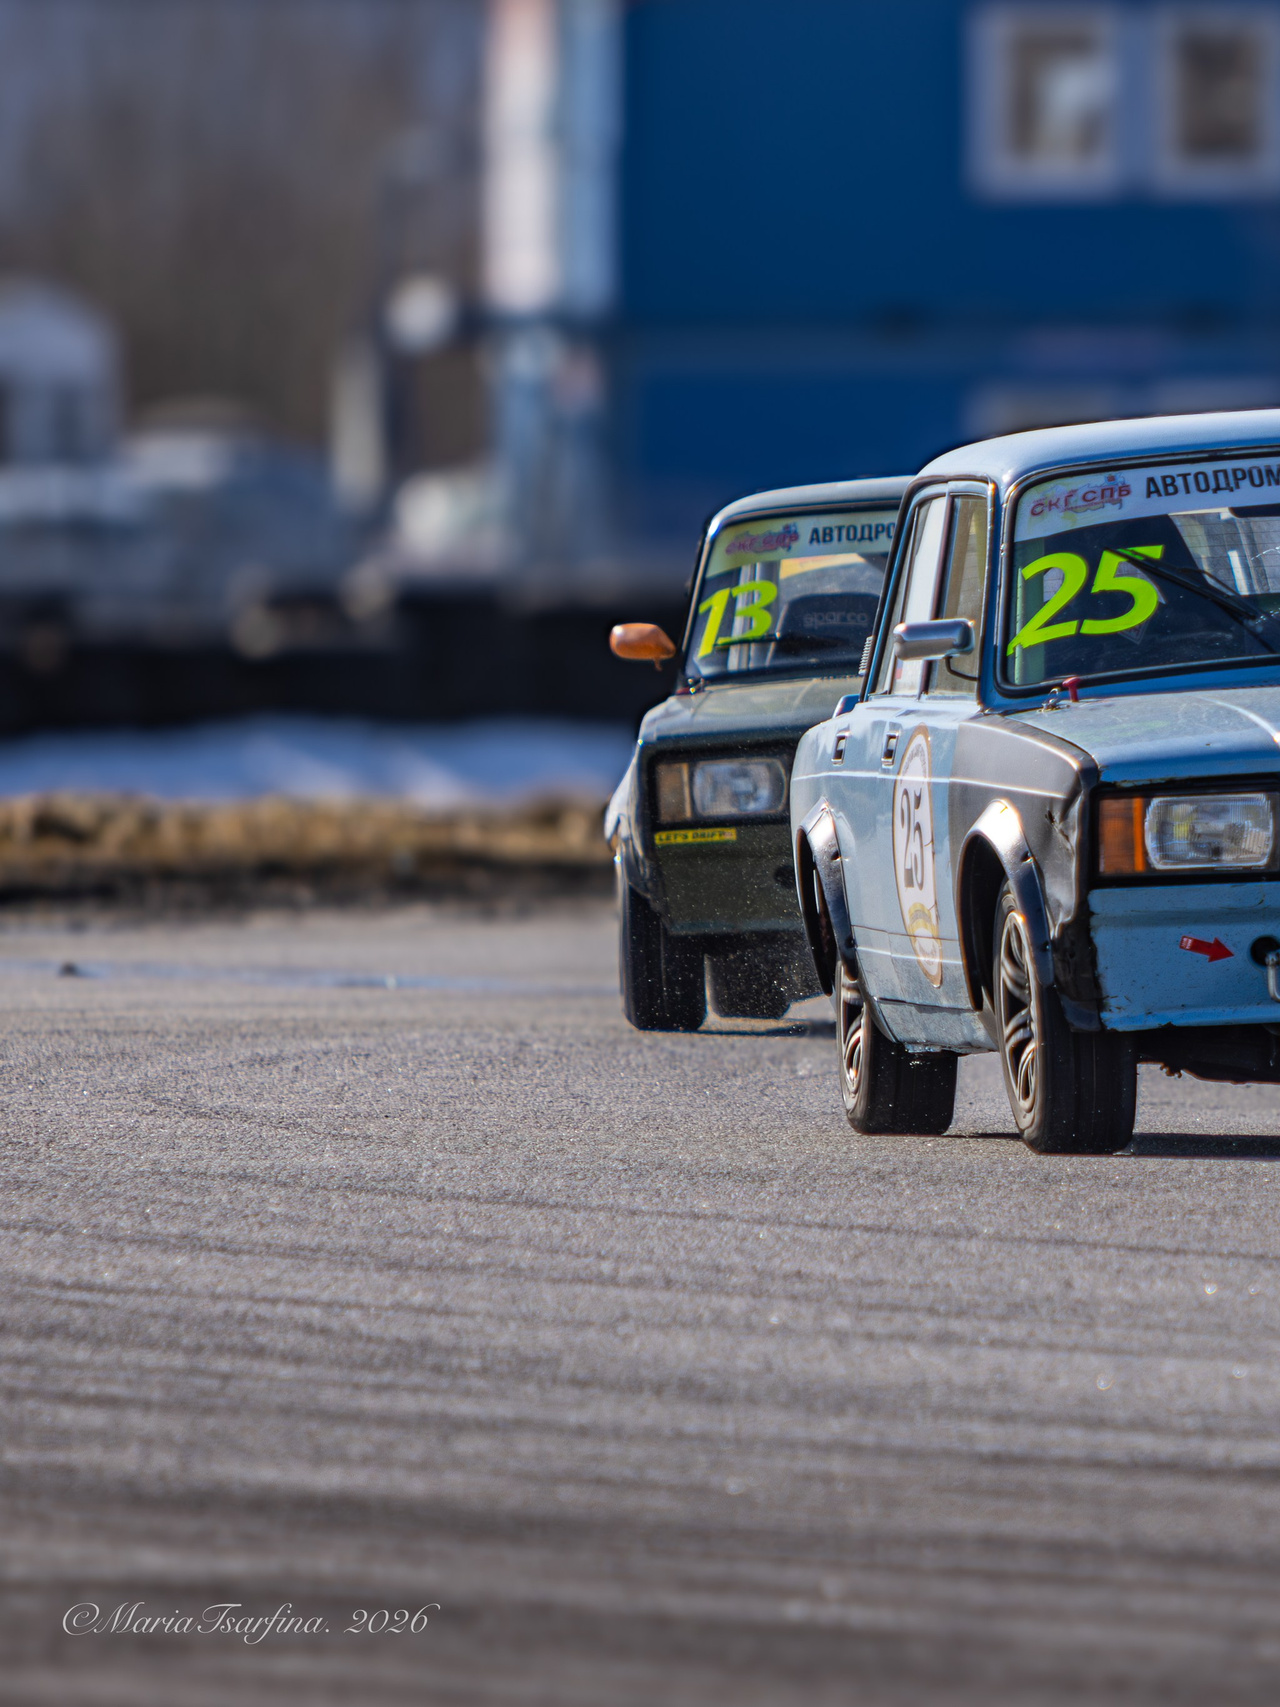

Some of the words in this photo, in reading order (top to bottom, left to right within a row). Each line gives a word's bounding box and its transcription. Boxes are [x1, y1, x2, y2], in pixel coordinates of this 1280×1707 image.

[1082, 484, 1132, 503] СПБ
[697, 580, 778, 659] 13
[803, 611, 869, 630] sparco
[1006, 544, 1165, 657] 25
[900, 788, 925, 891] 25
